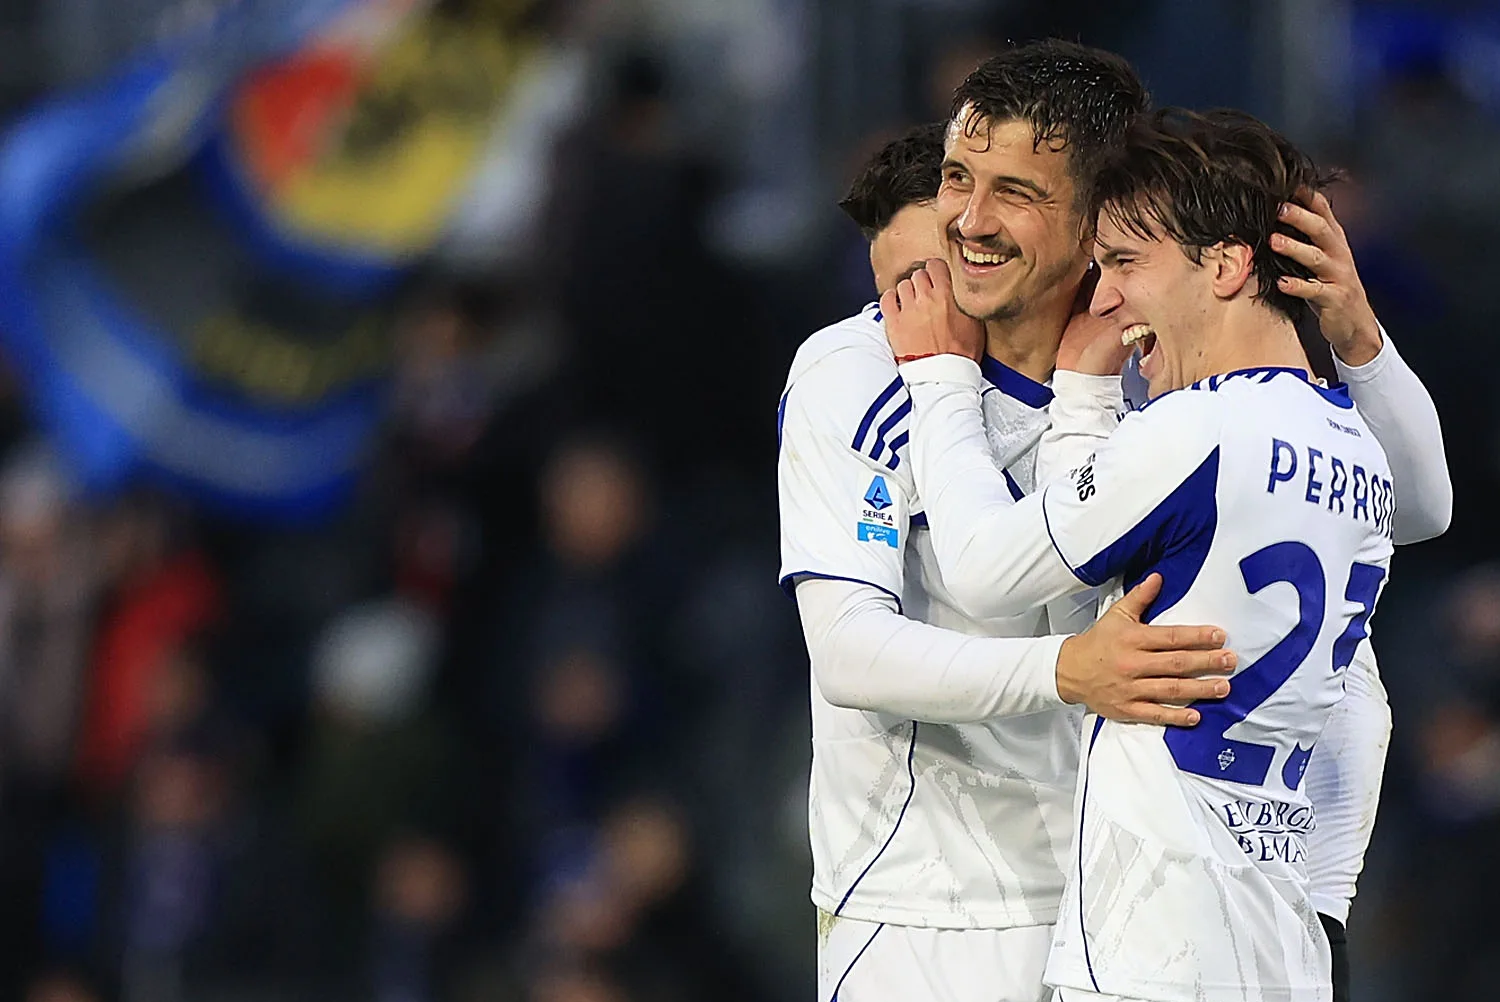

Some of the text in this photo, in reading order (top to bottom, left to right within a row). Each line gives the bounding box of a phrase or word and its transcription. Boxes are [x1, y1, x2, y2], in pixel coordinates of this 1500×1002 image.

[862, 509, 893, 522] SERIE A
[1267, 437, 1393, 540] PERRON
